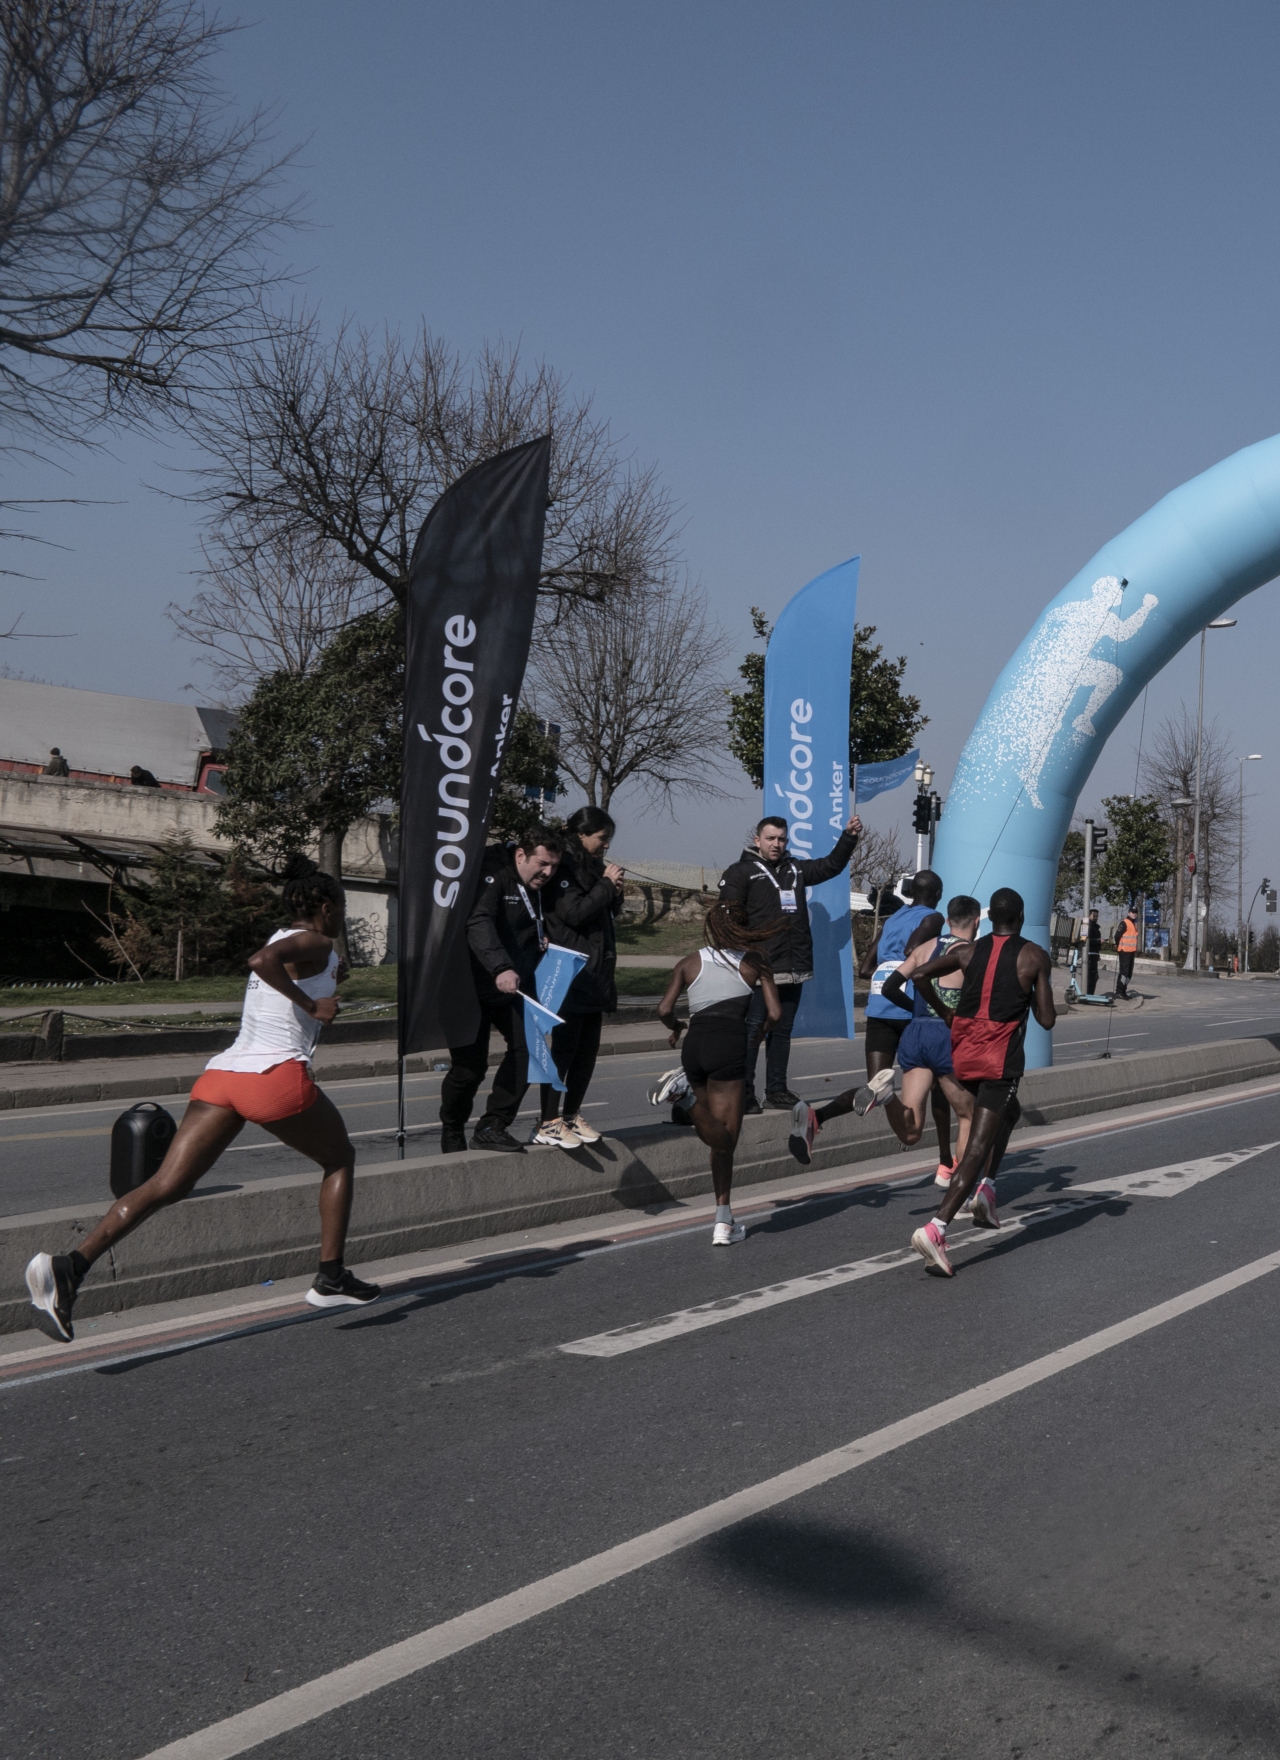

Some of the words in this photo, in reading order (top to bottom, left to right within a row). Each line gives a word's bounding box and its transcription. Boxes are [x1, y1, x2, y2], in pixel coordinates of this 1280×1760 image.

[417, 614, 477, 910] soundcore
[863, 765, 913, 785] soundcore
[829, 760, 844, 832] Anker
[541, 958, 562, 1011] soundco
